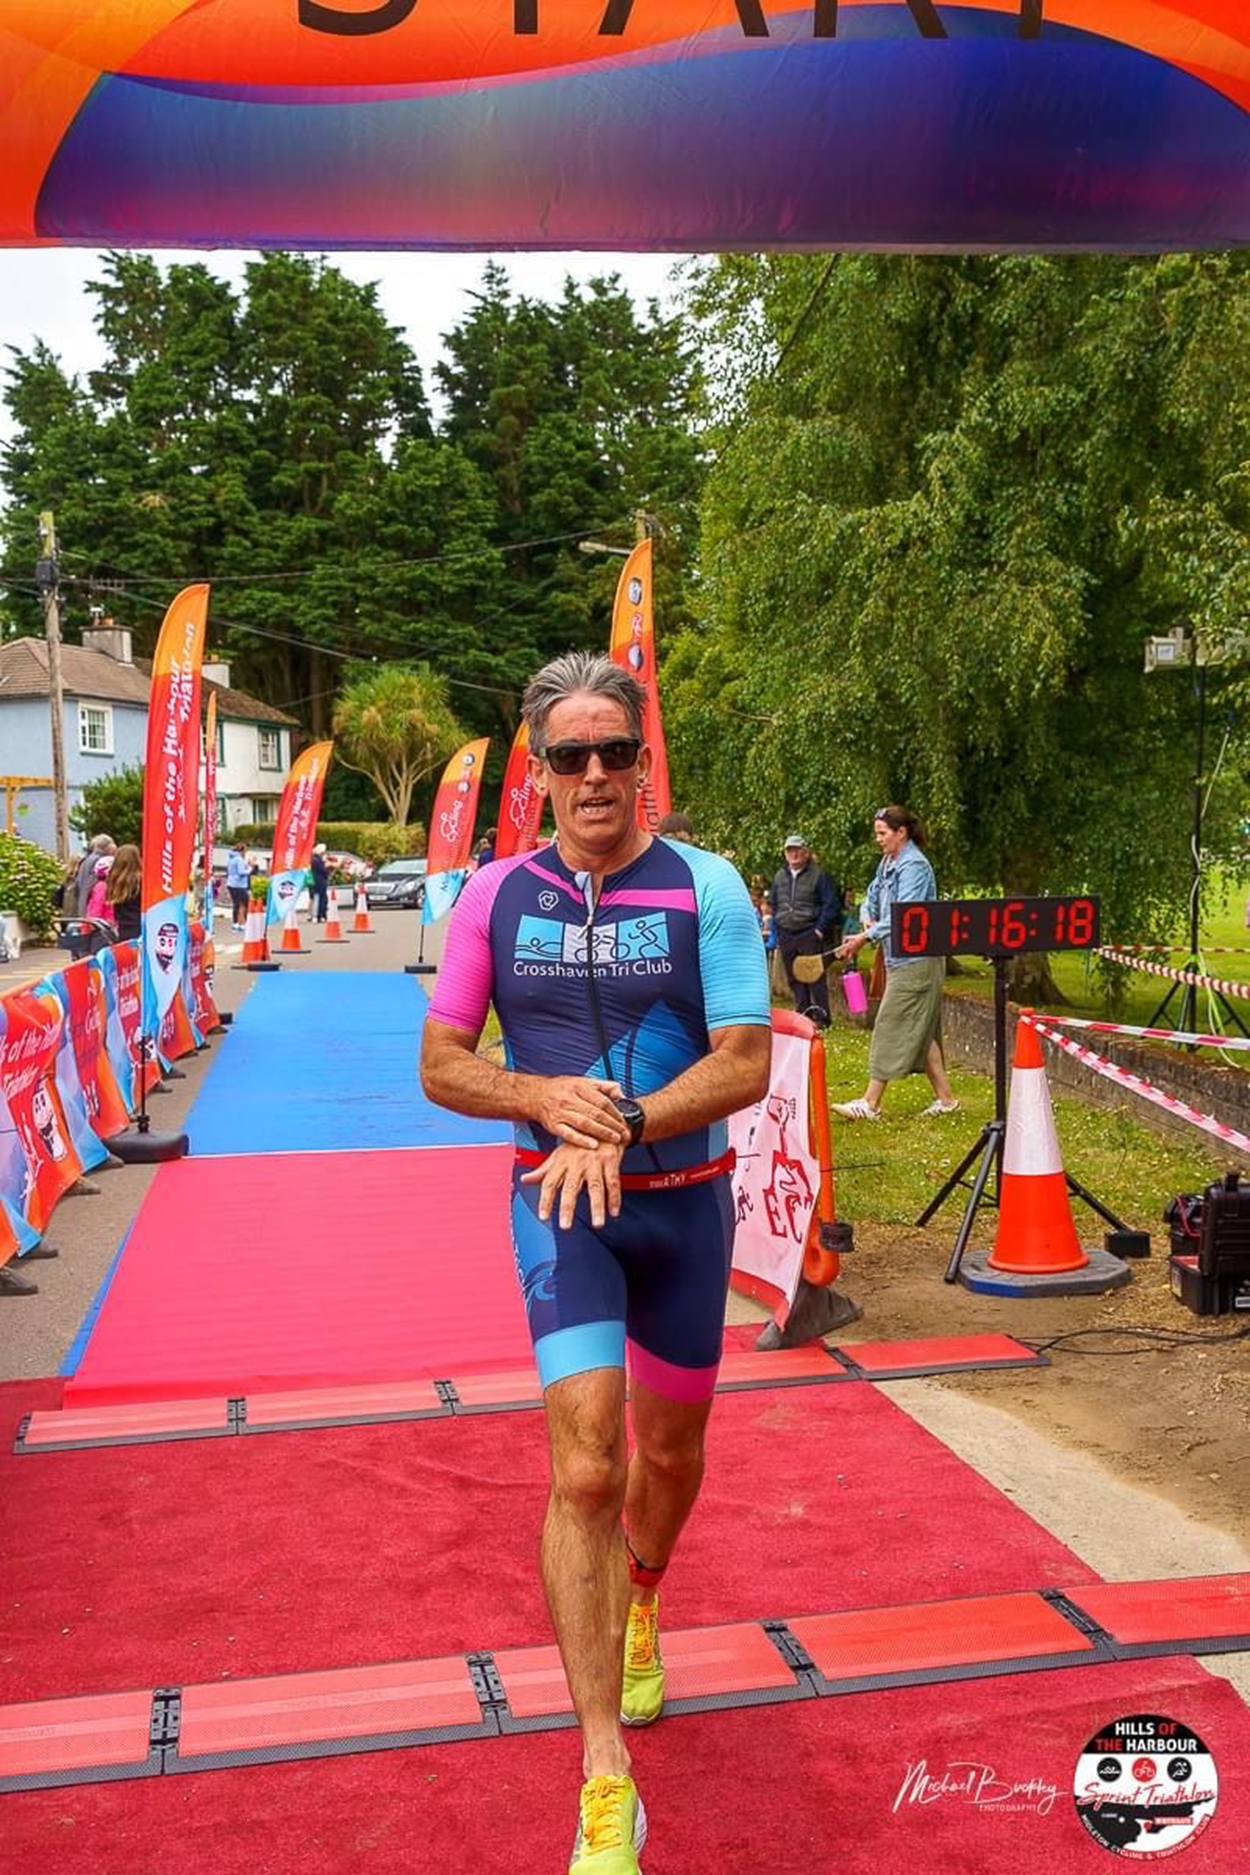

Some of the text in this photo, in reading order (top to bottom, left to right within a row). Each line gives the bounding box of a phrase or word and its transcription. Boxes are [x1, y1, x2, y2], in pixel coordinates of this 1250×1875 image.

[165, 762, 177, 801] the
[164, 803, 174, 834] of
[162, 839, 173, 893] Hills
[902, 900, 1094, 953] 01:16:18
[513, 959, 673, 978] Crosshaven Tri Club
